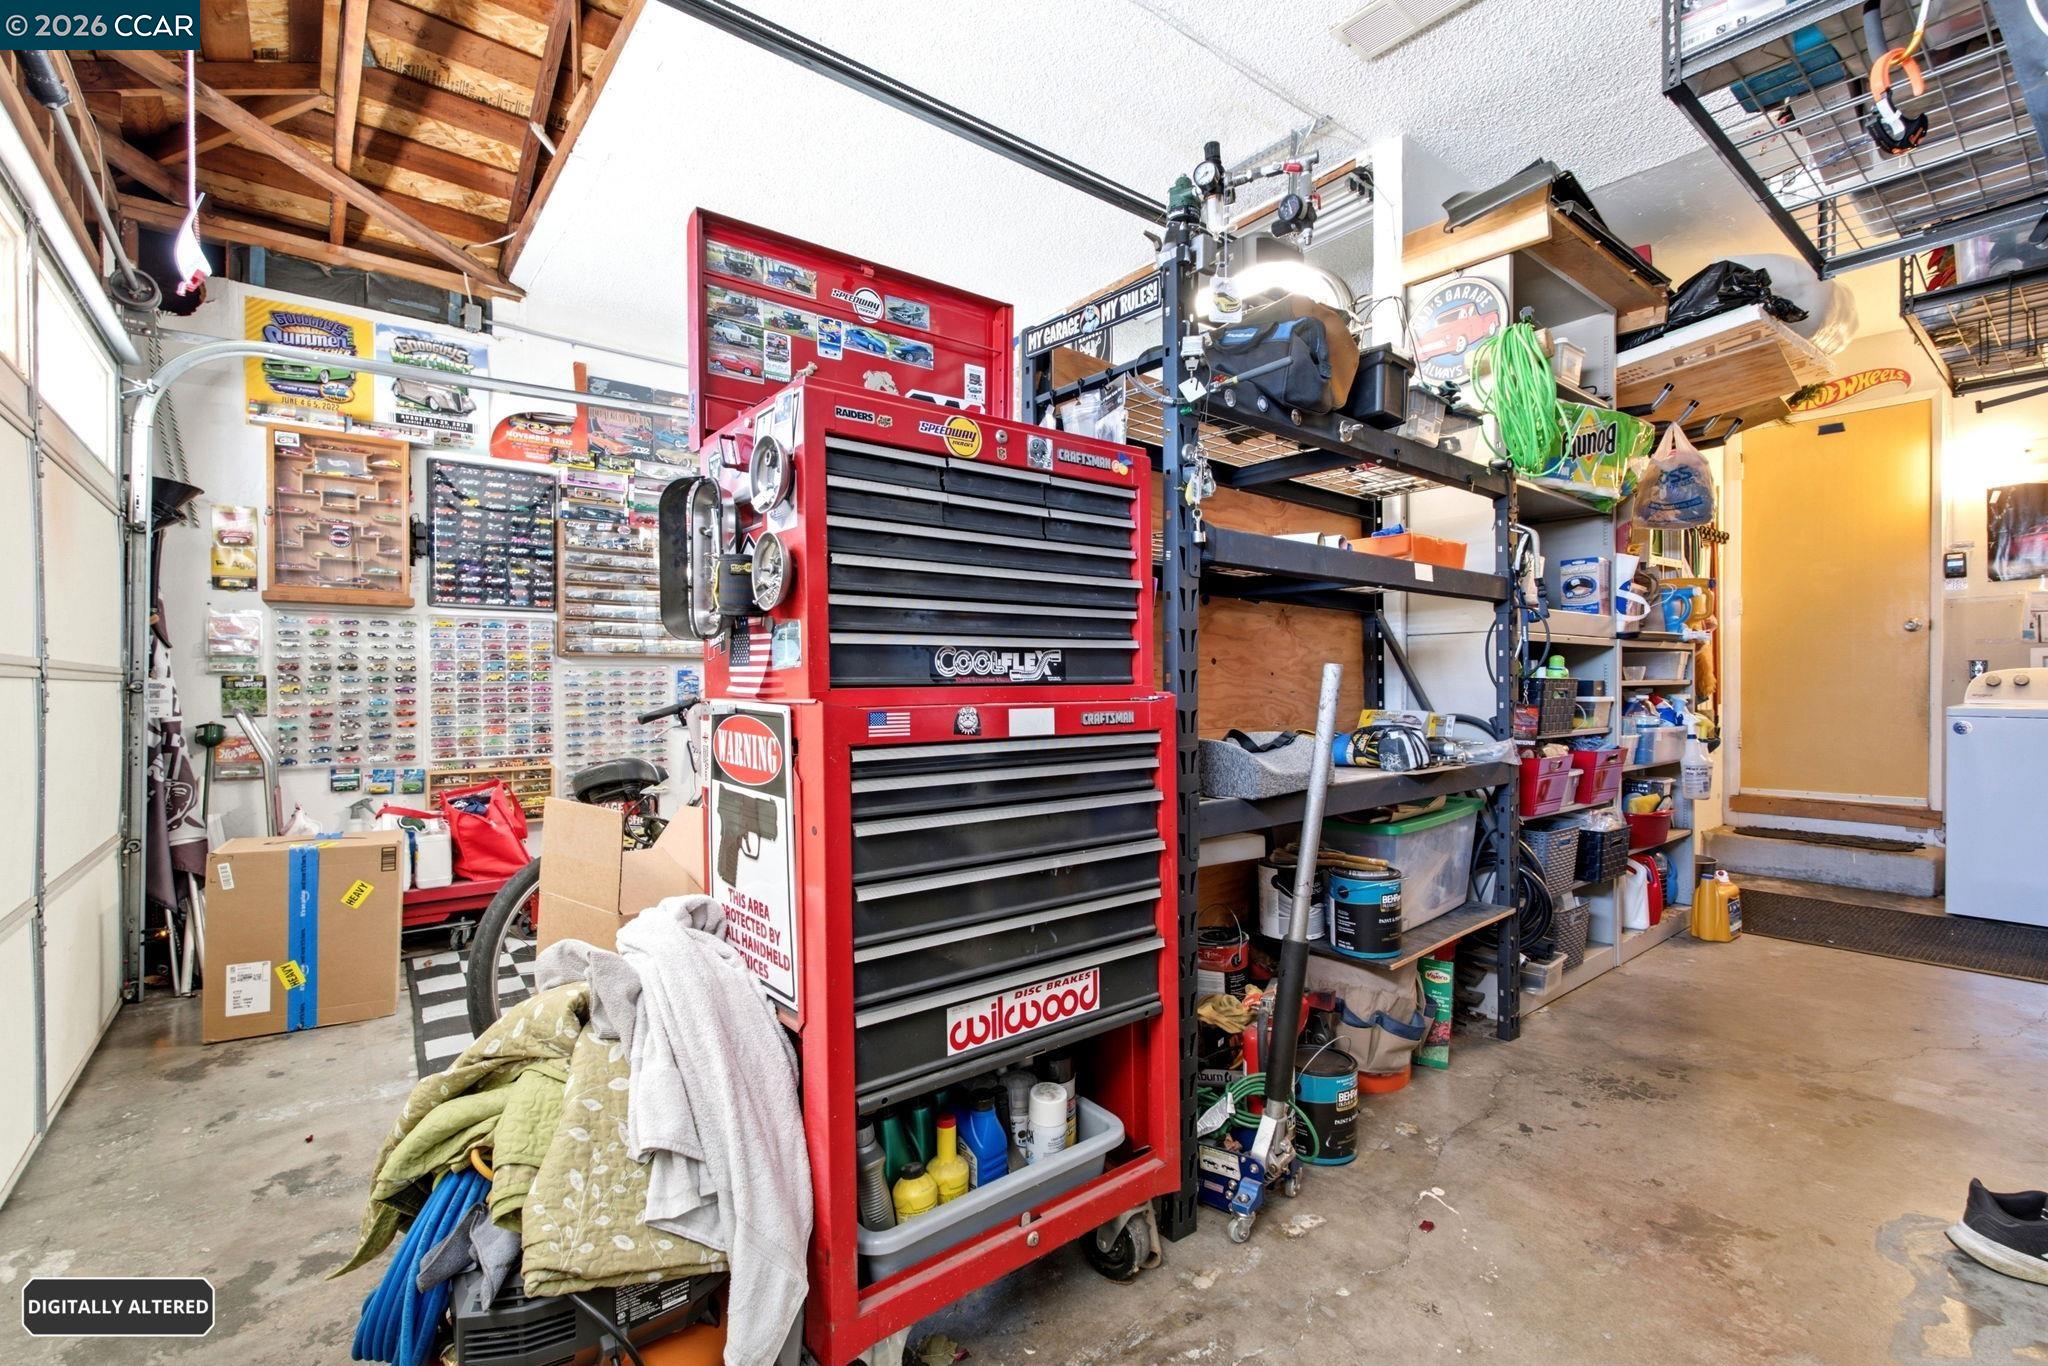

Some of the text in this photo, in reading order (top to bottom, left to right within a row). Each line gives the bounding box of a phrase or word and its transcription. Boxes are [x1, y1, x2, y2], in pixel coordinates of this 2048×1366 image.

[832, 289, 880, 311] SPEEDWAY
[1445, 286, 1494, 309] GARAGE
[1028, 330, 1043, 352] MY
[1043, 315, 1080, 345] GARAGE
[1101, 298, 1118, 324] MY
[1120, 281, 1158, 312] RULES!
[394, 337, 469, 364] GOODGUYS
[1422, 364, 1463, 379] ALWAYS
[835, 407, 874, 422] RAIDERS
[920, 422, 976, 442] SPEEDWAY
[952, 440, 974, 448] motors
[1057, 448, 1113, 470] CRAFTSMAN
[1080, 711, 1135, 726] CRAFTSMAN
[717, 728, 778, 775] WARNING
[346, 882, 368, 906] HEAVY
[728, 887, 771, 922] THIS AREA
[725, 924, 791, 972] ALL HANDHELD
[768, 926, 781, 947] BY
[280, 963, 300, 988] HEAVY
[1014, 971, 1092, 1000] DISC BRAKES
[949, 970, 1098, 1051] wilwood
